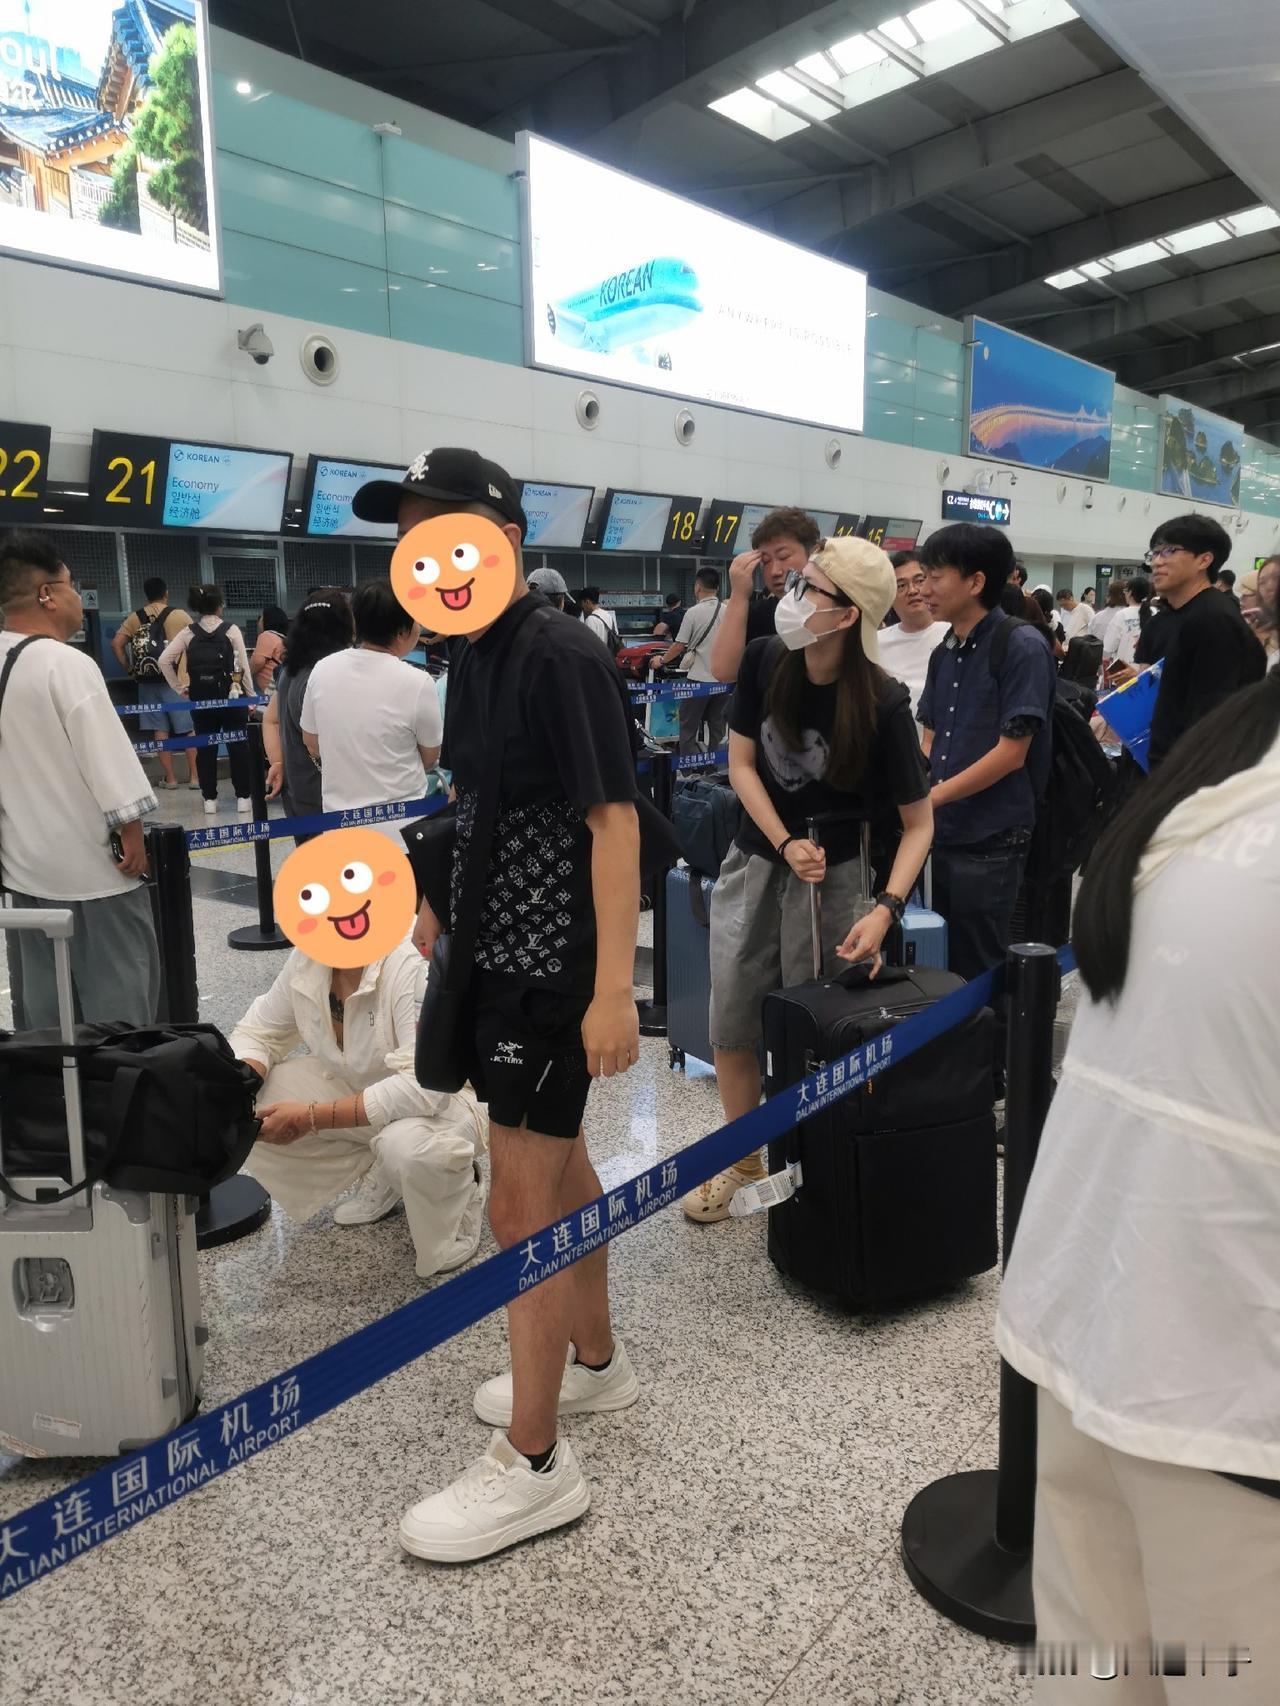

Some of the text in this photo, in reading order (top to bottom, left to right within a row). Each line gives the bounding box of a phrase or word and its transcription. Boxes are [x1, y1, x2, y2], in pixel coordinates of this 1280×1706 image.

[600, 259, 656, 307] KOREAN
[186, 453, 220, 463] KOREAN
[330, 469, 358, 478] KOREAN
[106, 457, 156, 505] 21
[172, 477, 219, 493] Economy
[317, 490, 353, 504] Econom
[671, 511, 695, 541] 18
[714, 514, 738, 544] 17
[340, 802, 406, 822] 大连国际机场
[191, 822, 270, 842] 大连国际机场
[796, 1055, 892, 1122] DALIAN INTERNATIONAL AIRPORT
[797, 1034, 893, 1108] 大连国际机场
[519, 1160, 678, 1274] 大连国际机场
[518, 1187, 677, 1292] DALIAN INTERNATIONAL AIRPORT
[0, 1375, 300, 1567] 大连国际机场
[72, 1459, 220, 1552] INTERNATIONAL
[227, 1409, 300, 1466] AIRPORT
